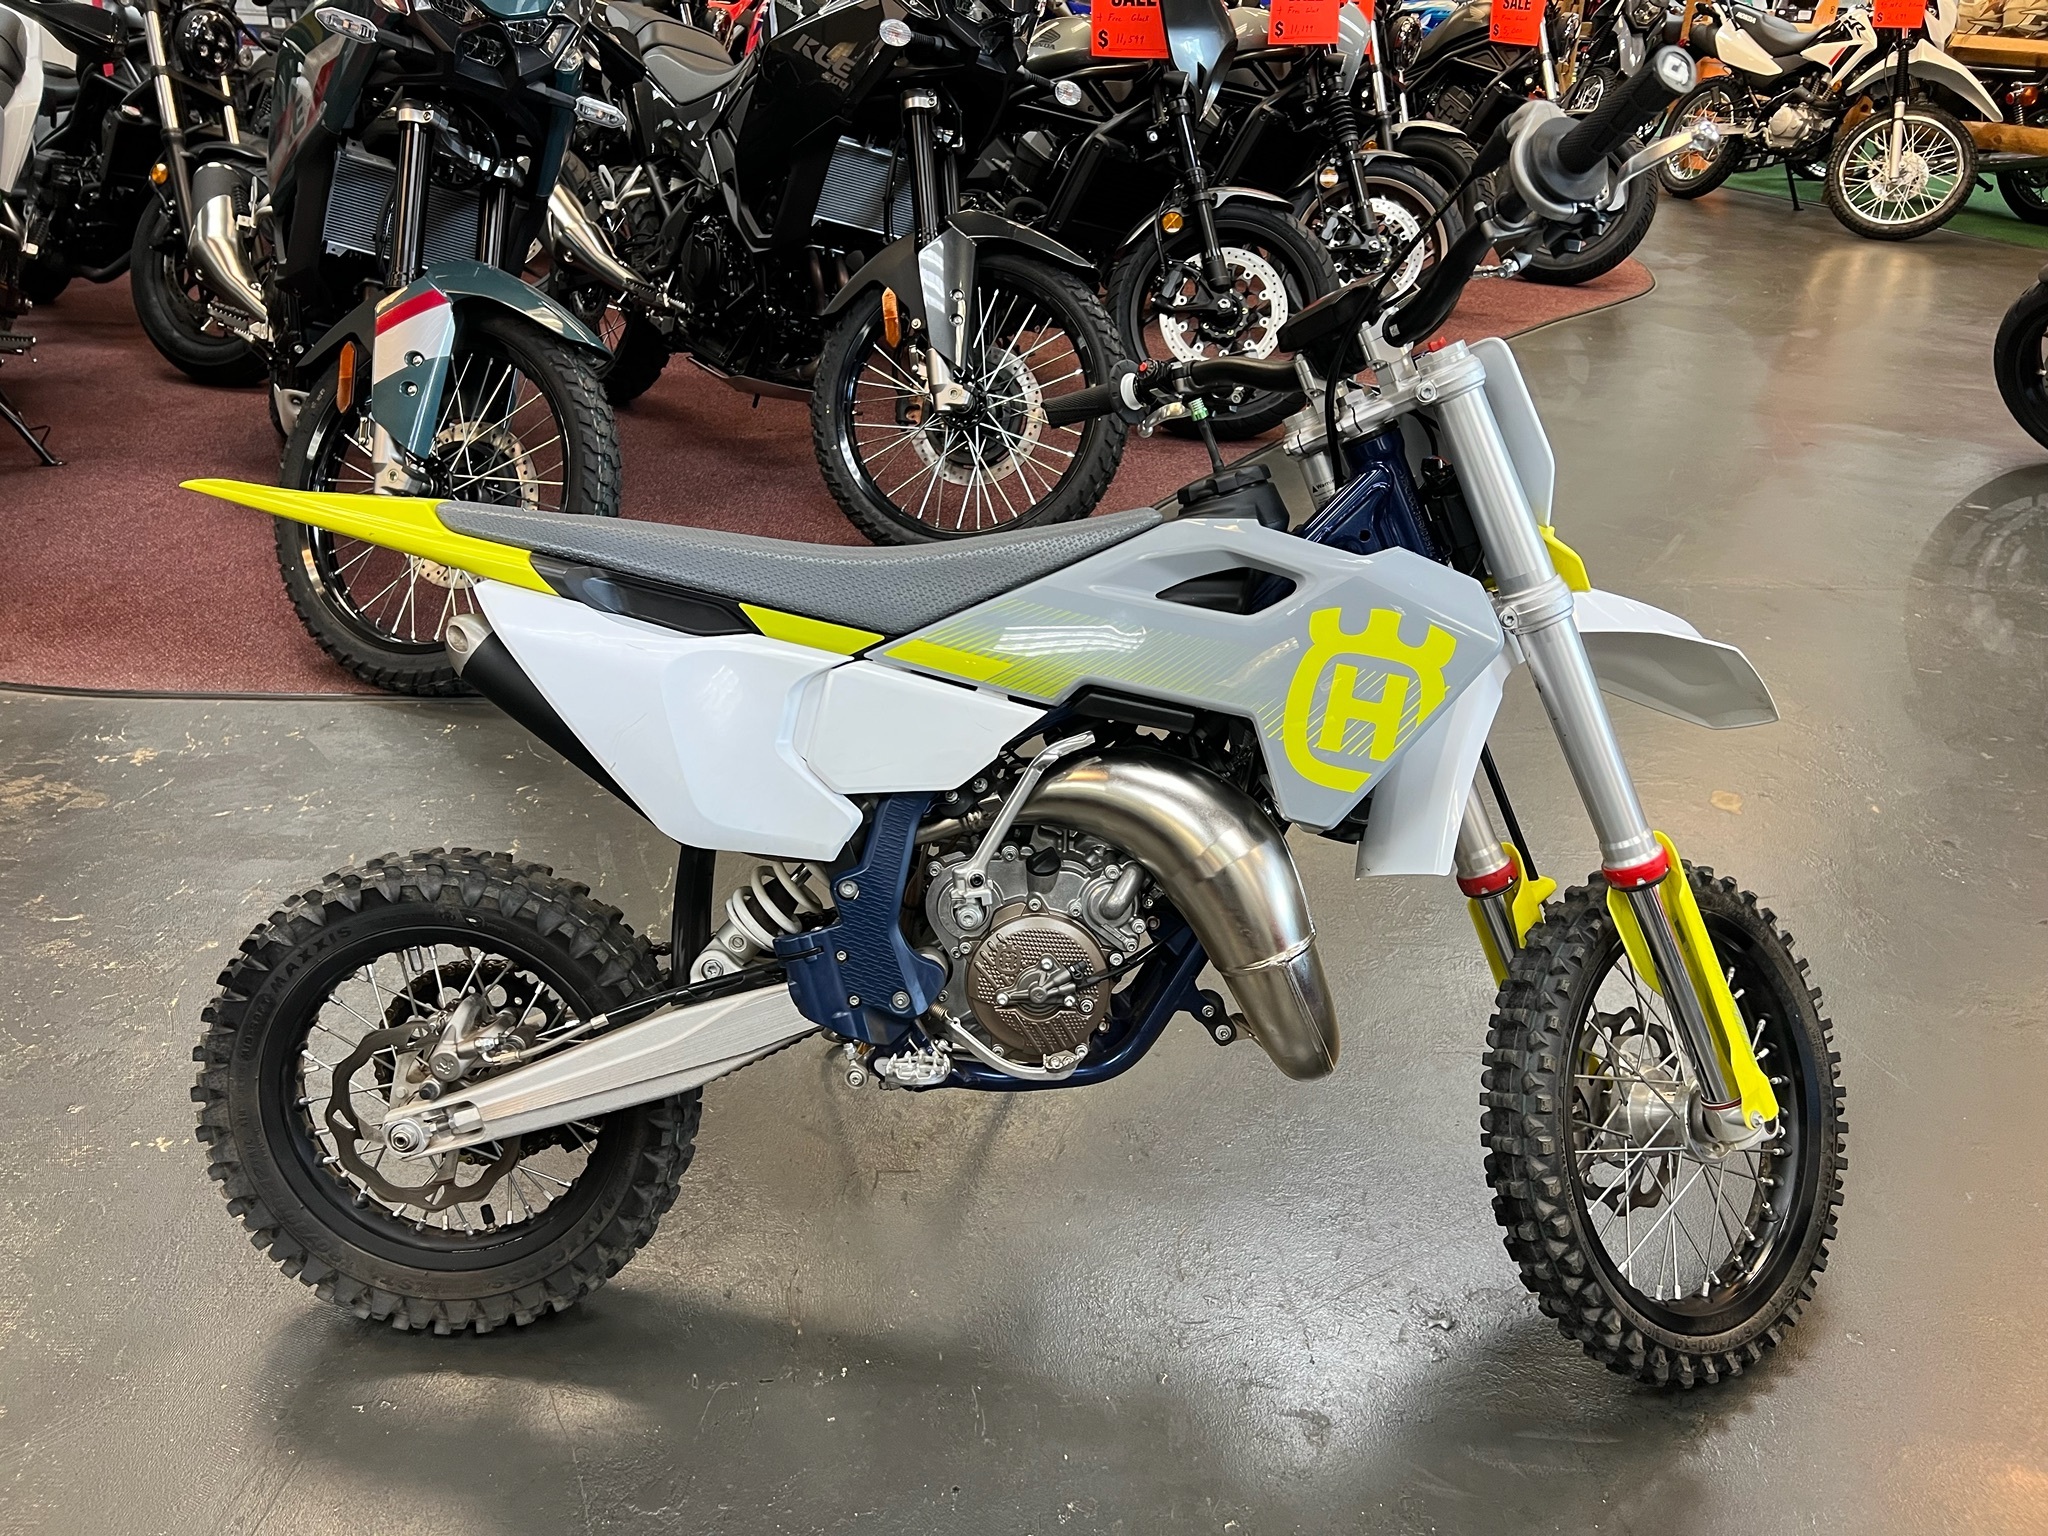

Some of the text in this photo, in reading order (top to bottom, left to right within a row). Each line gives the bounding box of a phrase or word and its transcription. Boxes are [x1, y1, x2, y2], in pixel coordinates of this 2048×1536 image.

[1503, 0, 1532, 11] SALE
[1274, 20, 1284, 38] $
[1493, 24, 1500, 37] $
[1030, 41, 1056, 50] ONDA
[1098, 29, 1145, 49] $ 11,599
[792, 33, 857, 79] KLE
[821, 71, 850, 92] 500
[269, 926, 352, 994] MAXXIS
